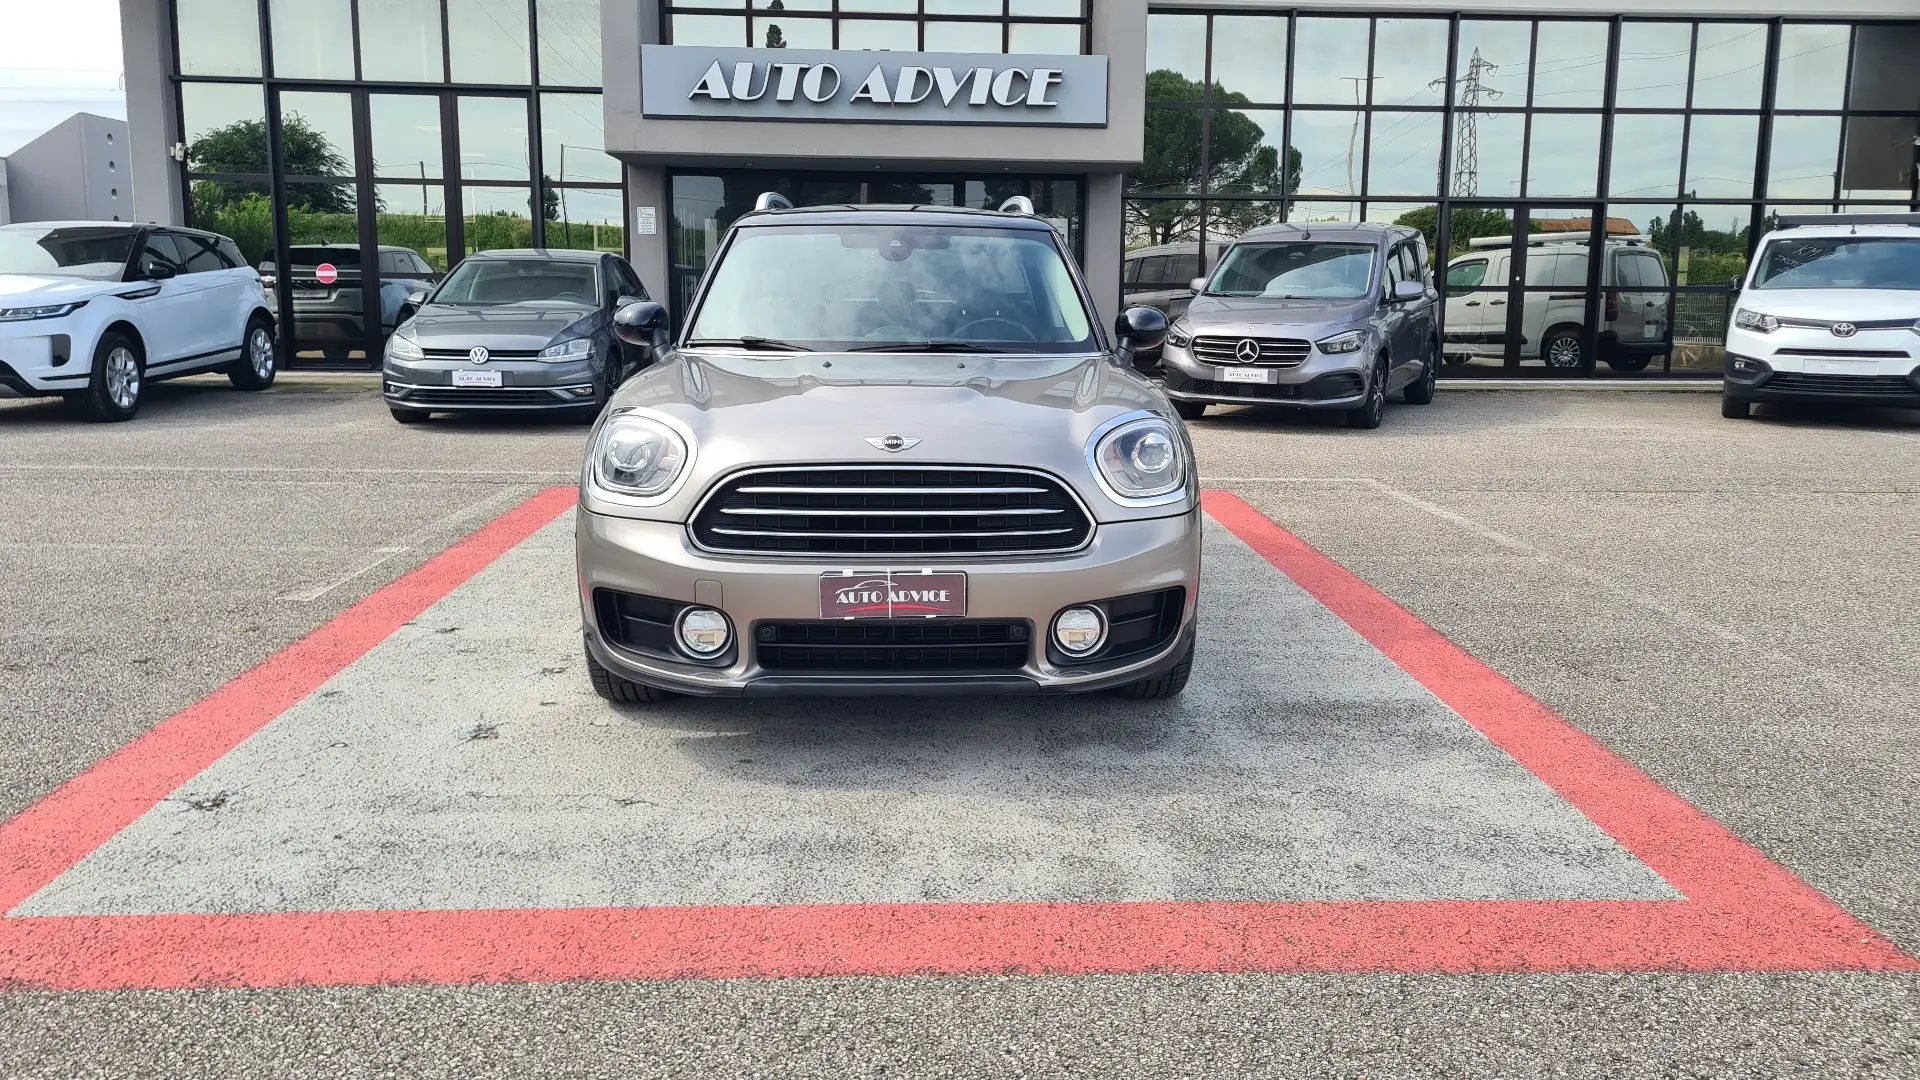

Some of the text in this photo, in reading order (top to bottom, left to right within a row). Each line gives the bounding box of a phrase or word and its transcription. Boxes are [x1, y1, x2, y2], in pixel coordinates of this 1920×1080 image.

[687, 58, 1064, 107] AUTO ADVICE
[835, 590, 951, 604] AUTO ADVICE
